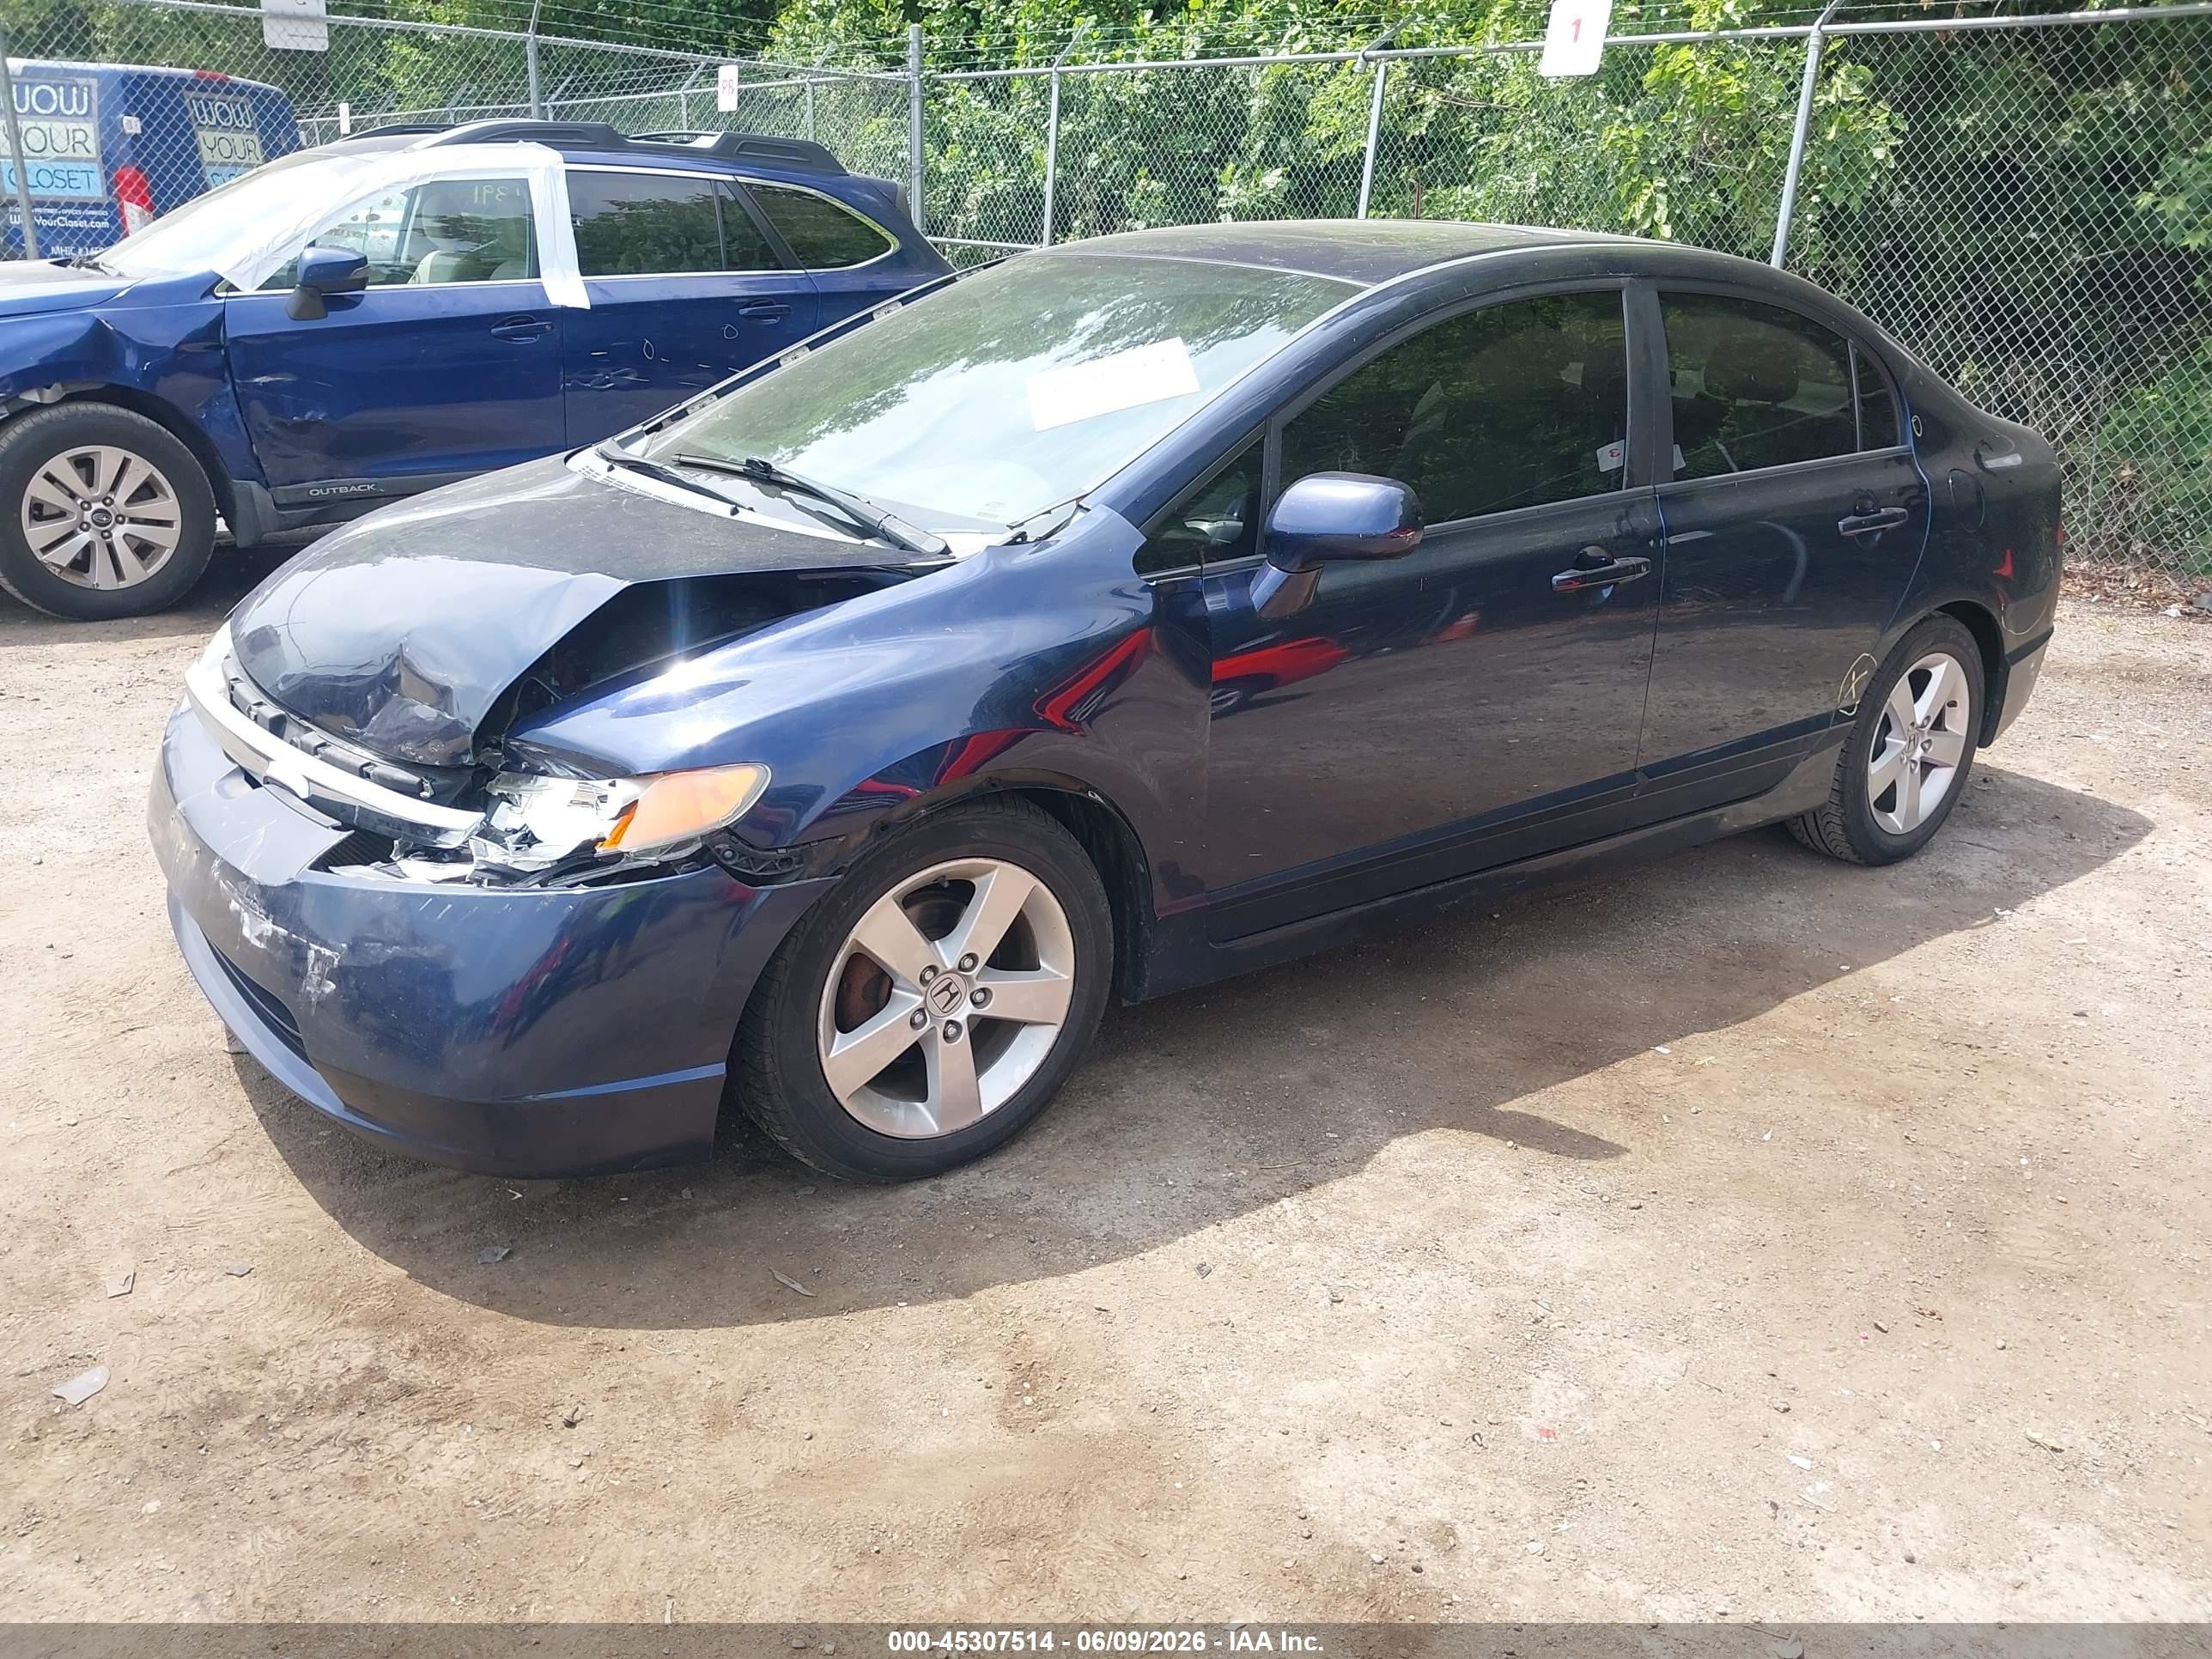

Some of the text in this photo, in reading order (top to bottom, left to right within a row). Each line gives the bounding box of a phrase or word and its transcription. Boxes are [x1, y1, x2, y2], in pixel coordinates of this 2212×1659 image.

[1571, 17, 1582, 43] 1
[191, 99, 252, 129] WOW
[202, 136, 260, 161] YOUR
[9, 214, 110, 228] WYourCloset.com
[309, 483, 376, 496] OUTBACK
